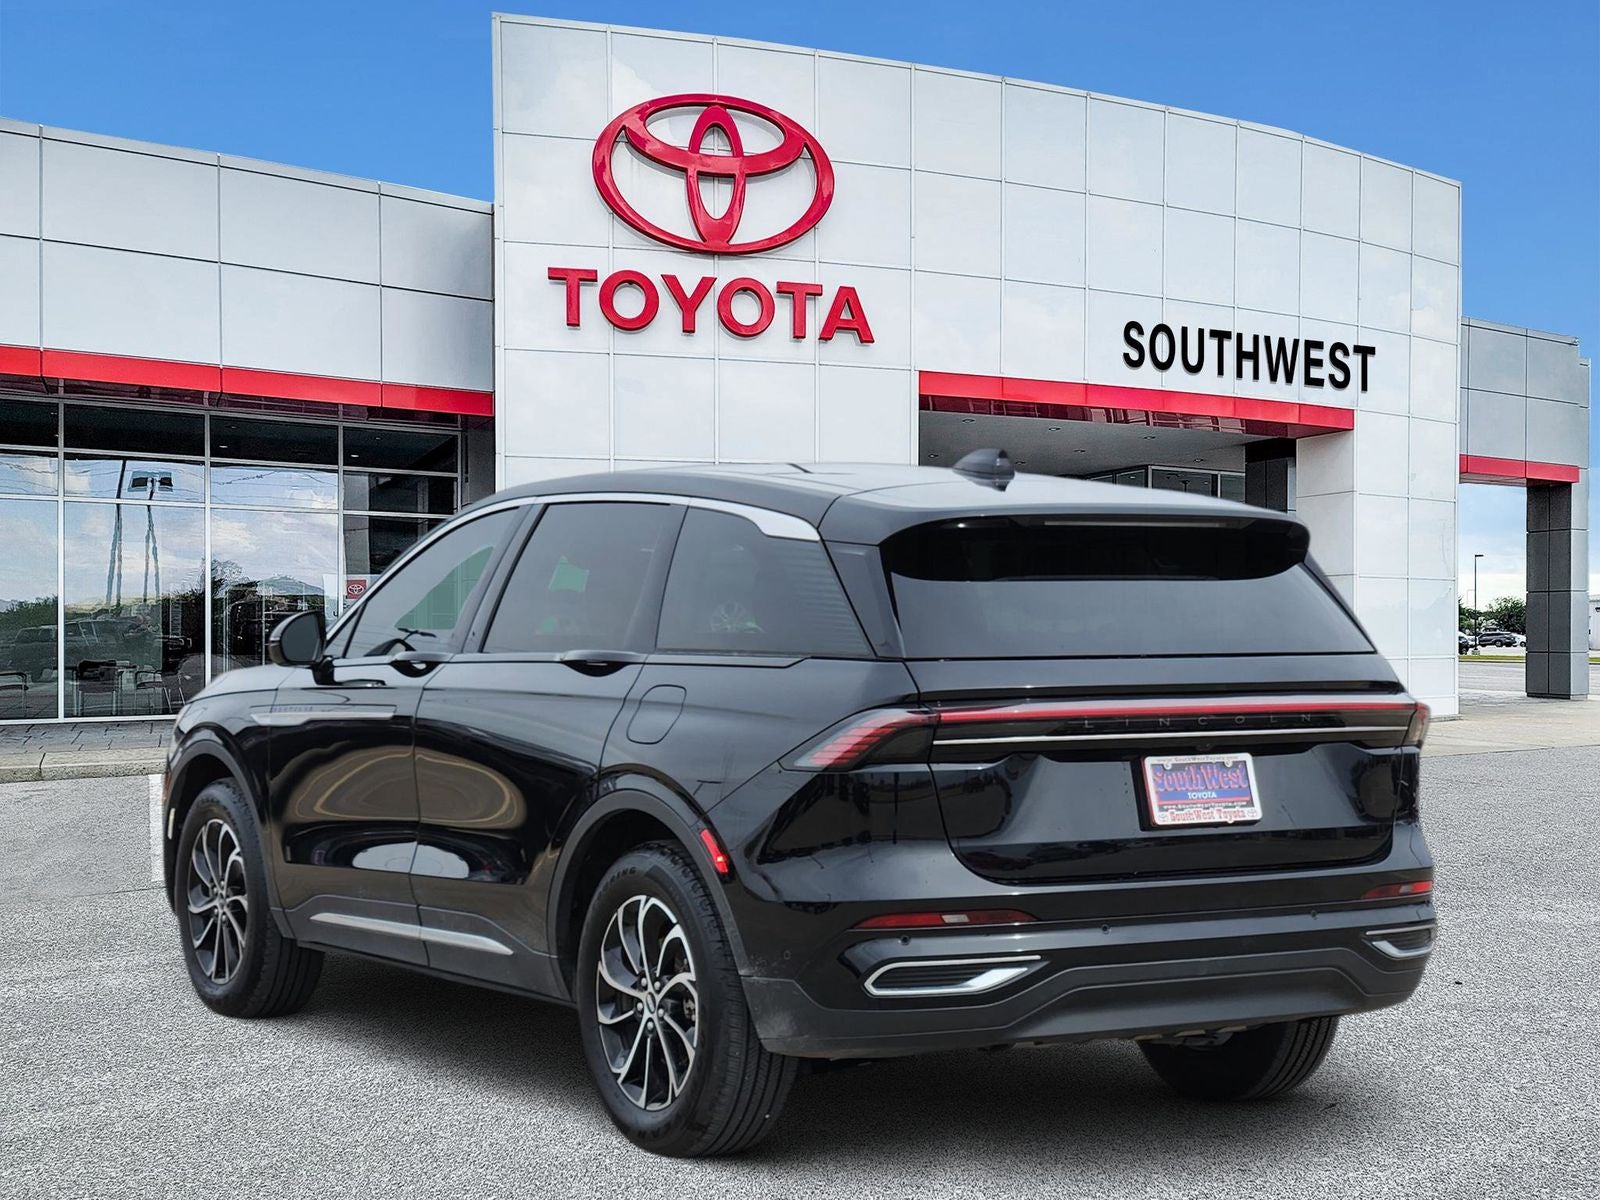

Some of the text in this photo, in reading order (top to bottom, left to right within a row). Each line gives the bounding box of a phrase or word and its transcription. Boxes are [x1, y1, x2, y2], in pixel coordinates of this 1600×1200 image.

[548, 267, 875, 344] TOYOTA
[1123, 320, 1376, 393] SOUTHWEST
[1085, 713, 1312, 729] LINCOLN
[1187, 791, 1217, 800] TOYOTA
[1217, 808, 1246, 820] Toyota
